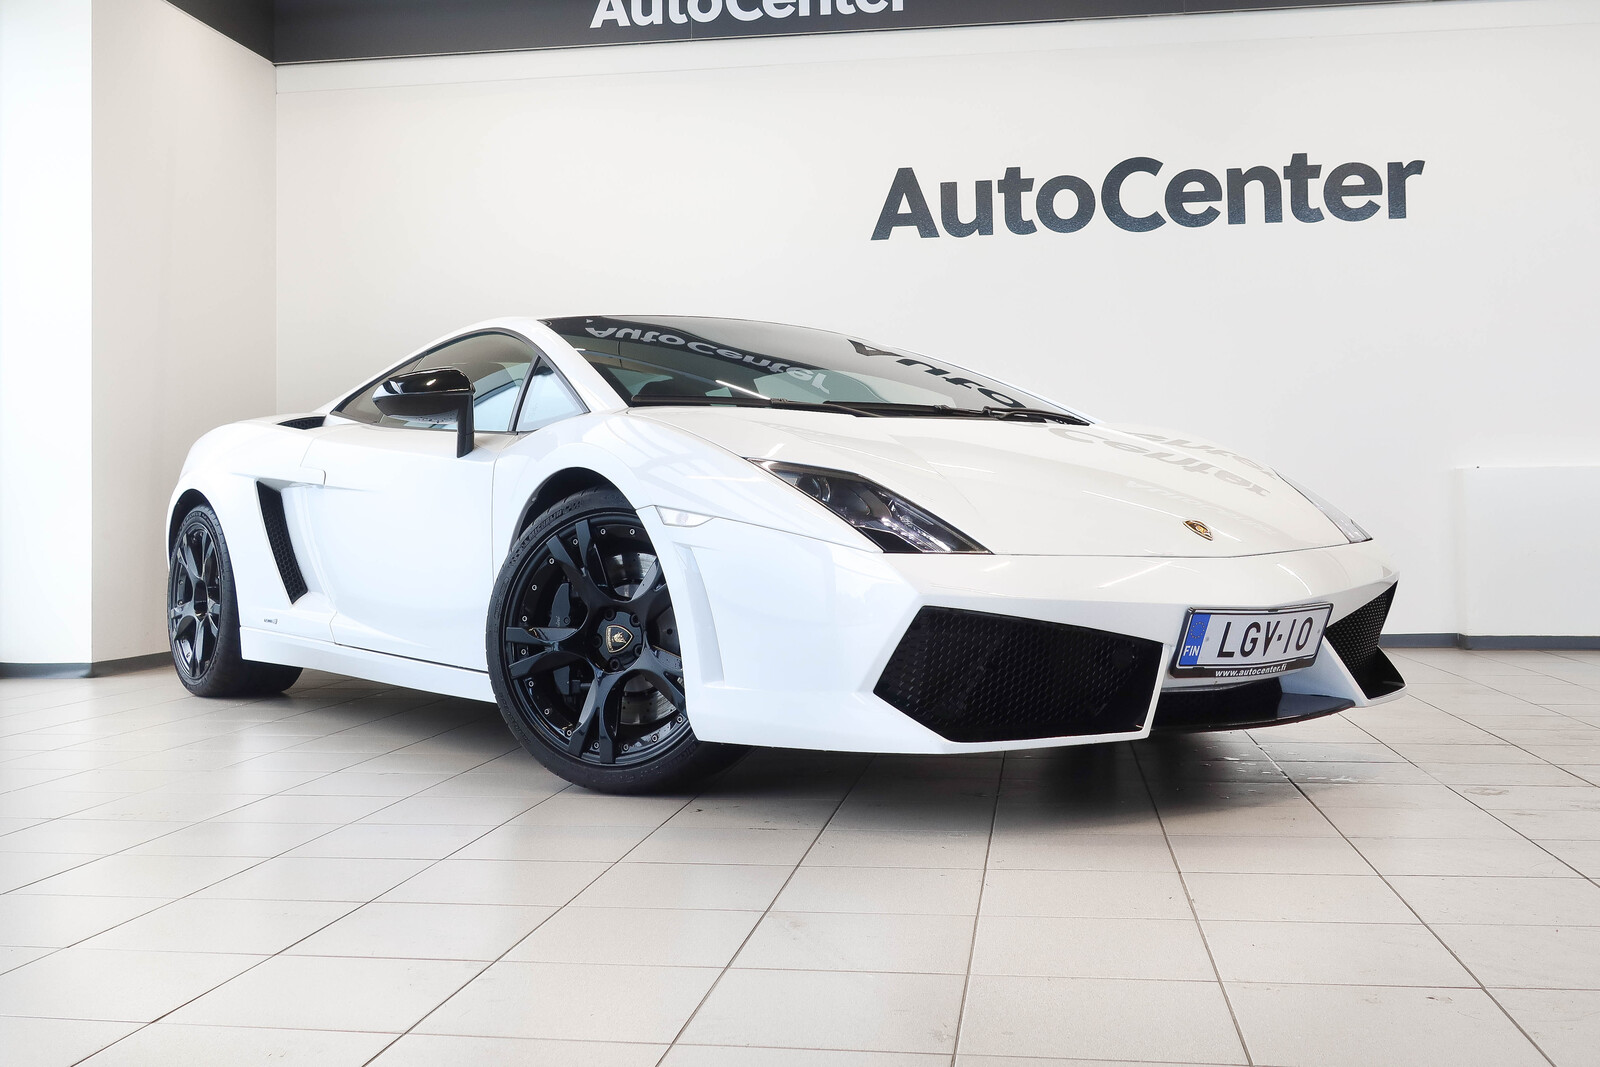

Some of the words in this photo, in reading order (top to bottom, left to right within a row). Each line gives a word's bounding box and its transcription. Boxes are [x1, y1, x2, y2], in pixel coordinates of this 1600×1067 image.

[870, 152, 1426, 241] AutoCenter
[1216, 616, 1314, 658] LGV-10
[1183, 645, 1201, 657] FIN
[1215, 664, 1287, 677] www.autocenter.fi
